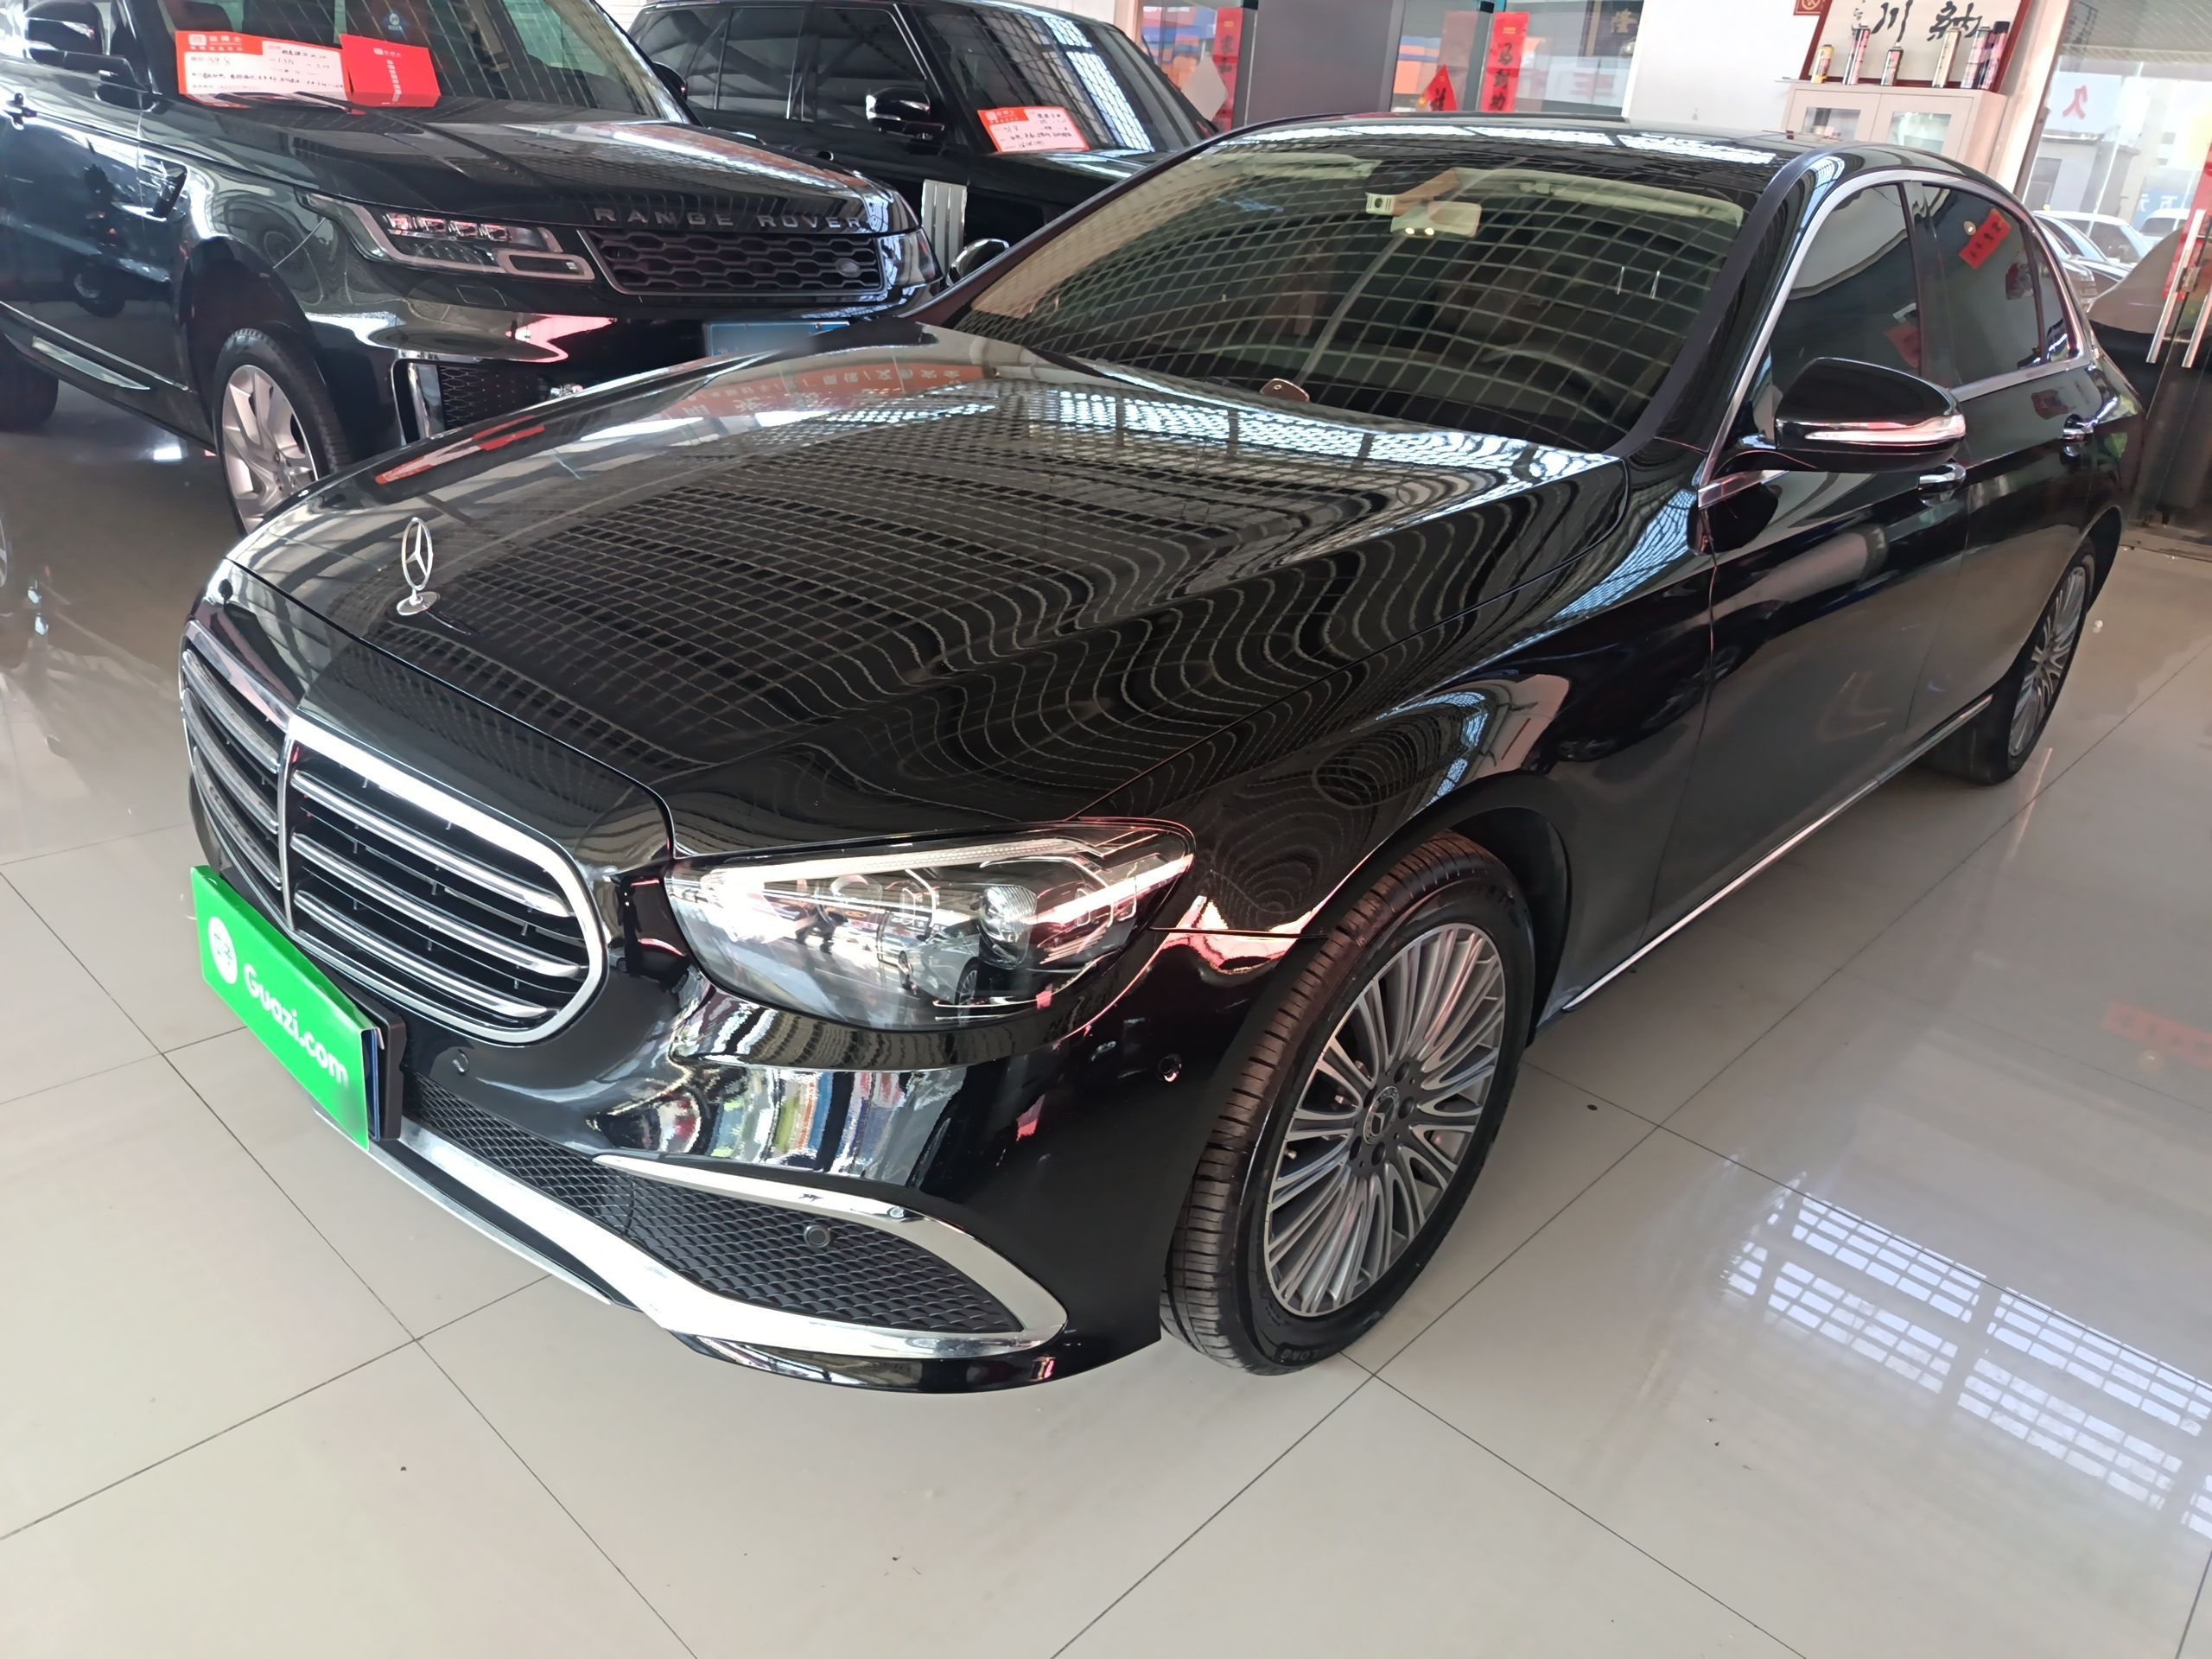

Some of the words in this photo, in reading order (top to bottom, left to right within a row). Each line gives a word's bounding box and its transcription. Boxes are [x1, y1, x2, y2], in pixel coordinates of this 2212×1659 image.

[594, 207, 734, 226] RANGE
[760, 214, 861, 228] ROVER
[244, 962, 349, 1087] Guazi.com
